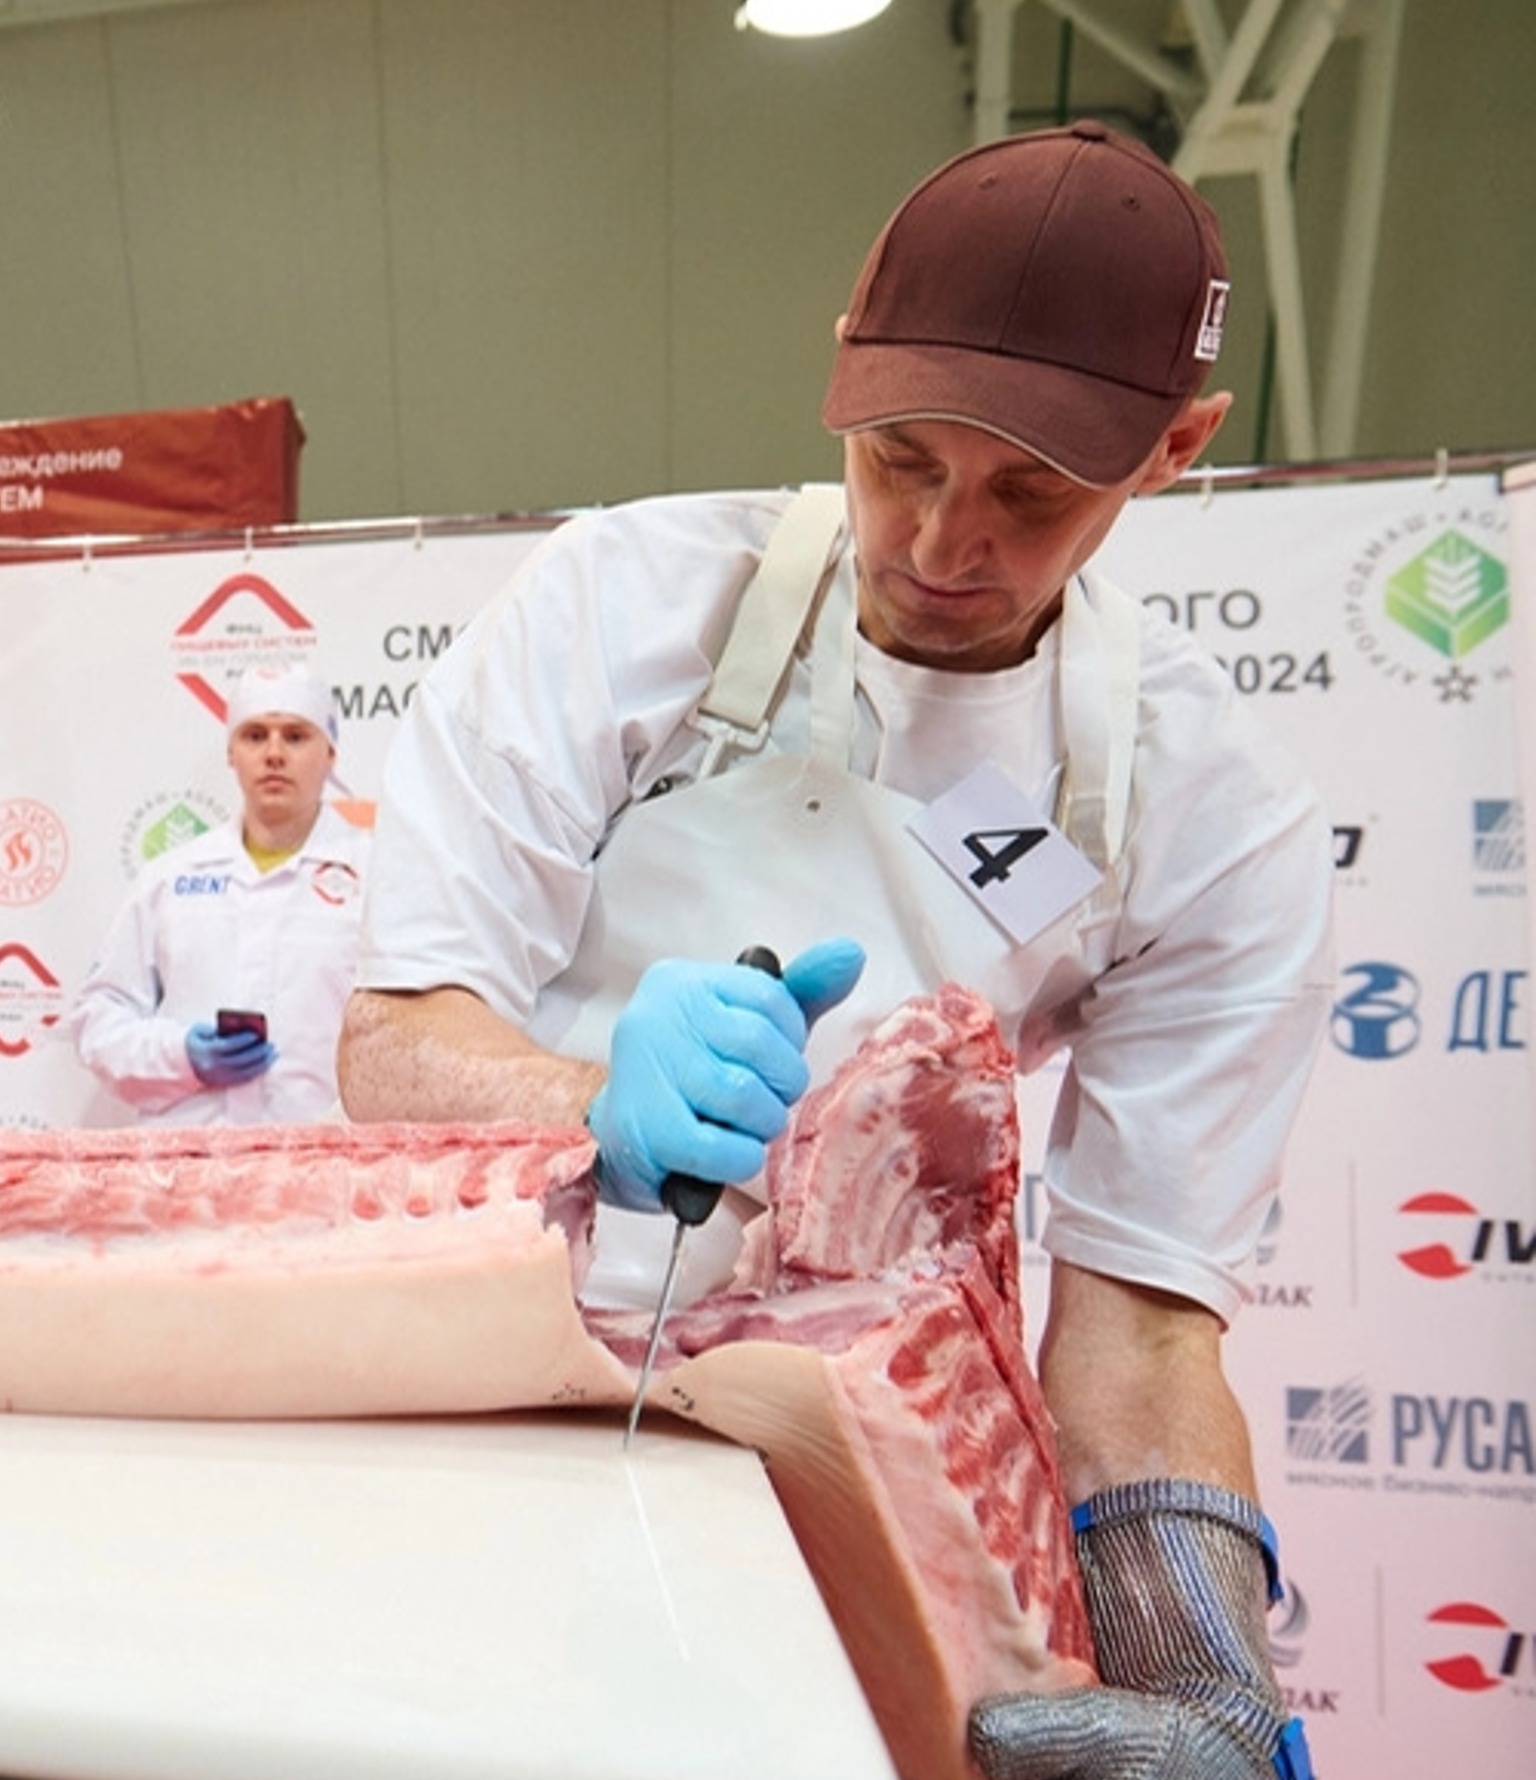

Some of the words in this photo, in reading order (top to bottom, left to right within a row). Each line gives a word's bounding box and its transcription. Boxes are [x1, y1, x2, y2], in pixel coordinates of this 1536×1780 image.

[383, 624, 468, 663] СМ
[1214, 652, 1333, 696] 024
[962, 827, 1050, 890] 4
[1446, 970, 1530, 1052] ДЕ
[1391, 1394, 1536, 1477] РУСА
